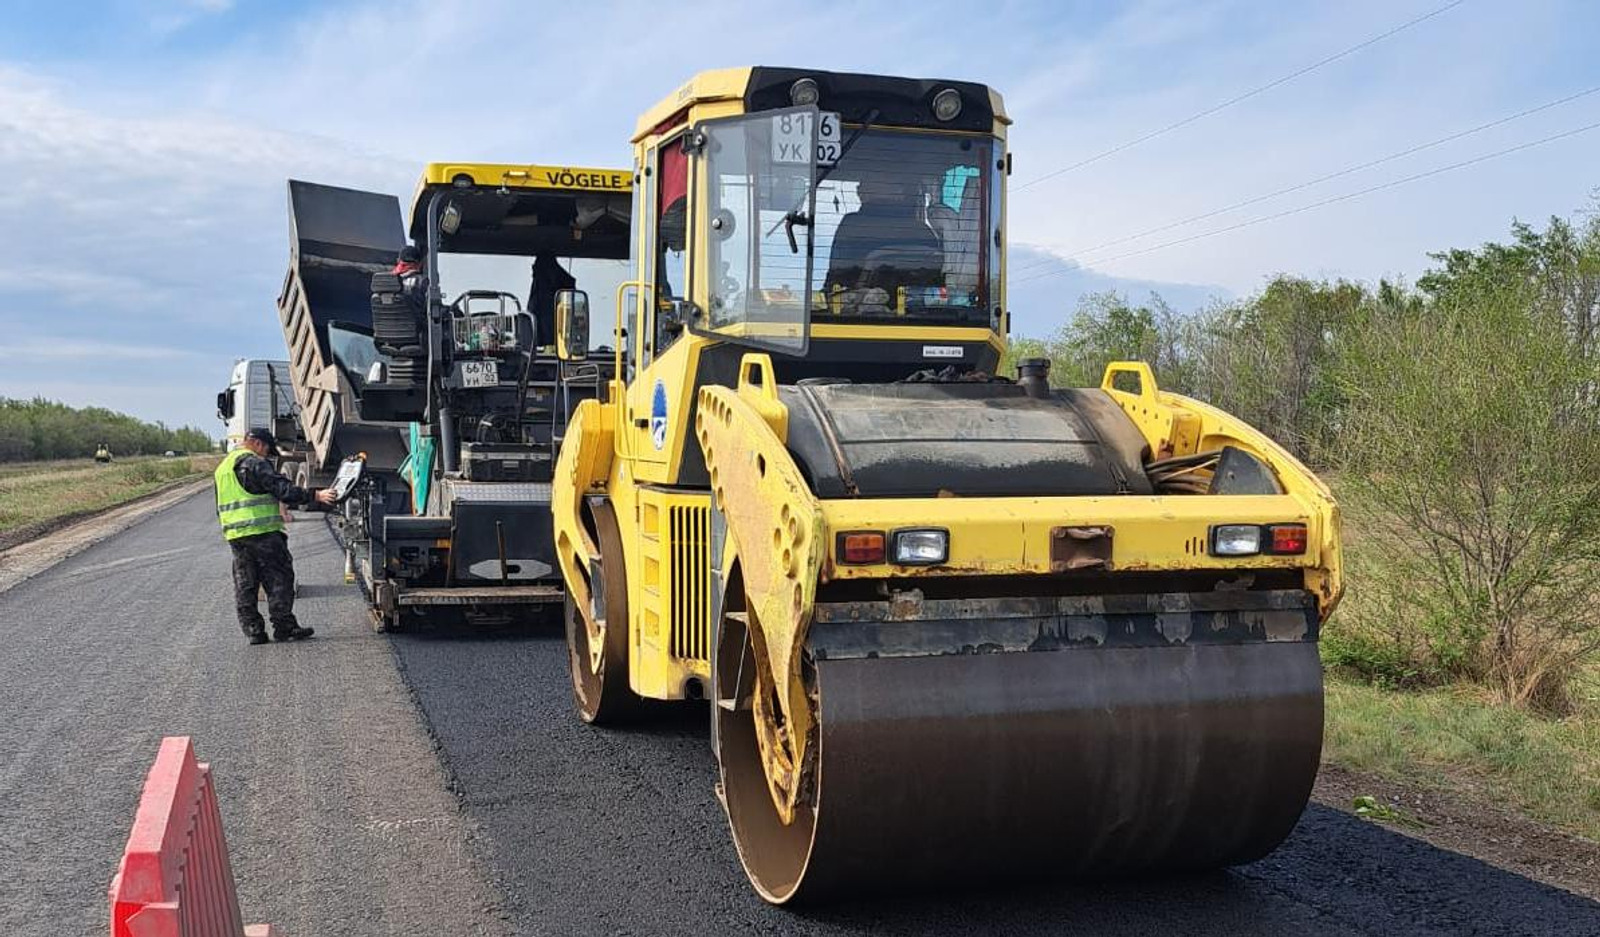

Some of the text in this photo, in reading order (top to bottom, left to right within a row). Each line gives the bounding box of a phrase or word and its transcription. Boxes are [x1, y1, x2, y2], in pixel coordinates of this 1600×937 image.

[780, 114, 832, 137] 816
[816, 145, 836, 161] 02
[546, 168, 622, 188] VÖGELE
